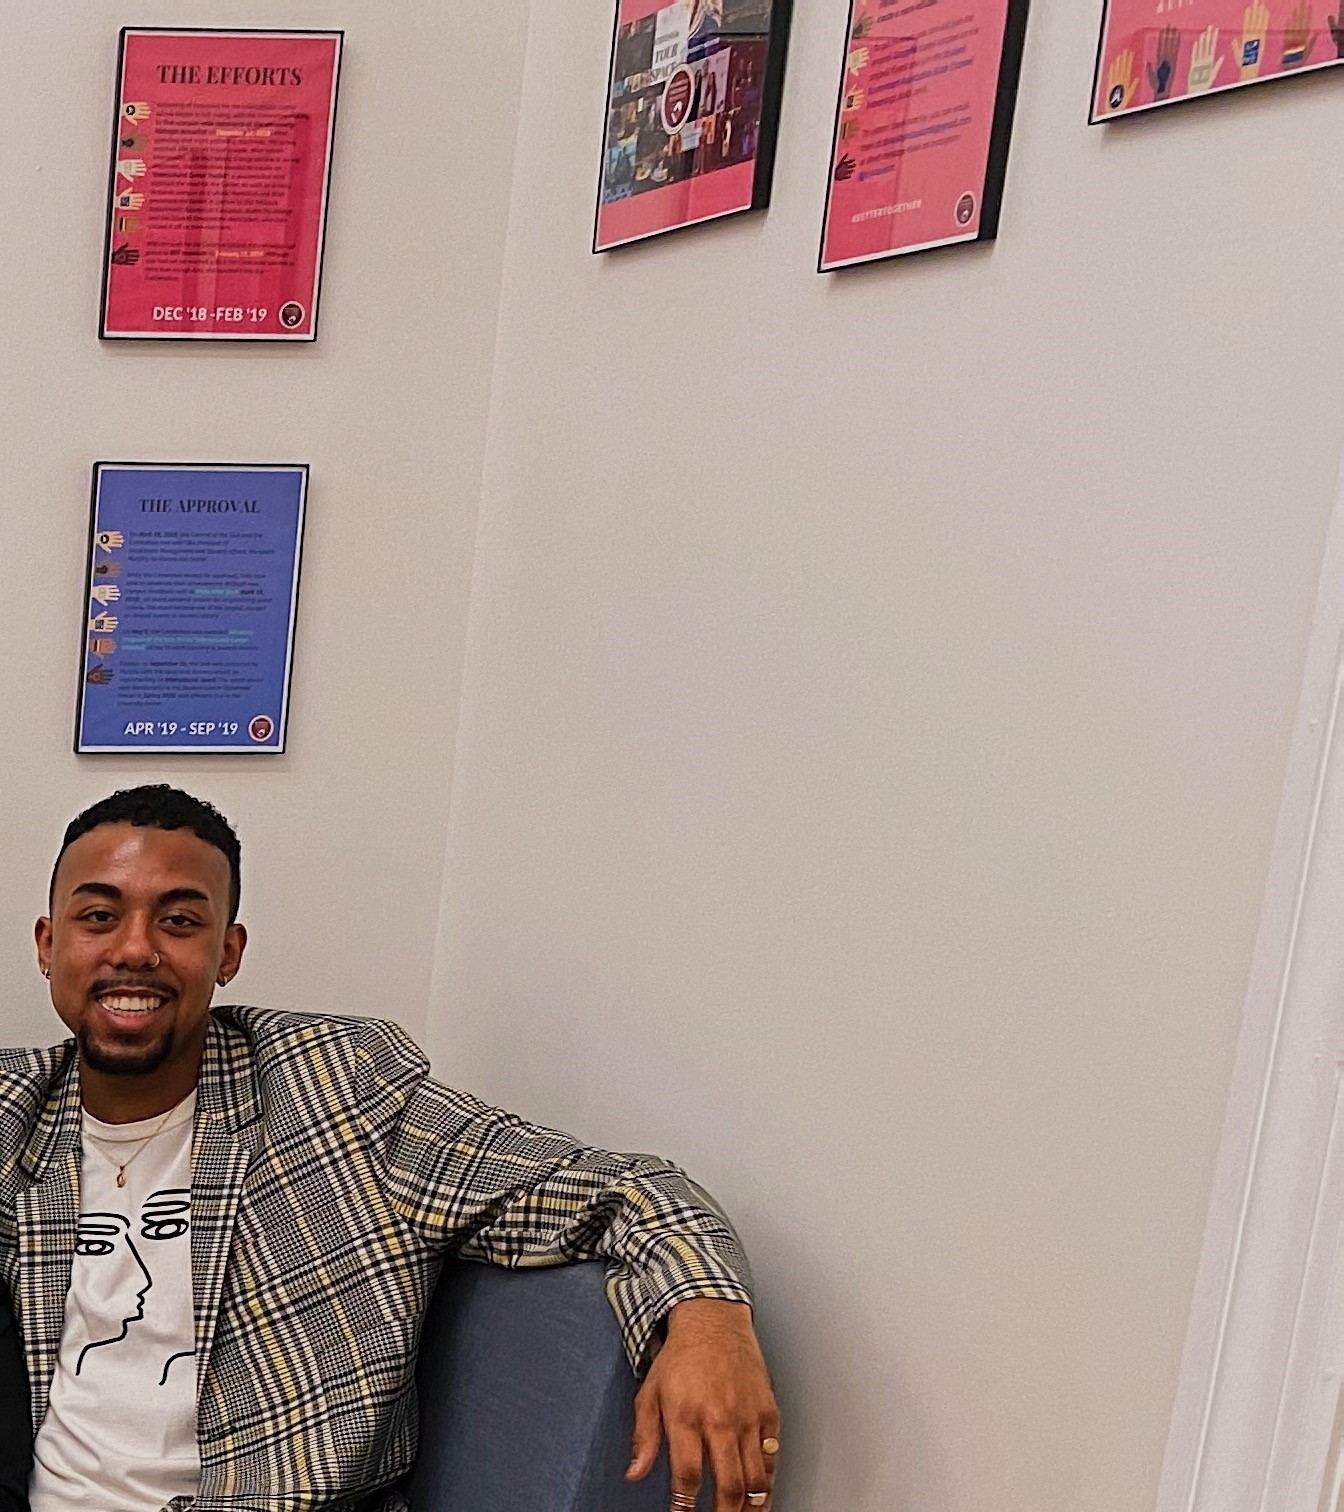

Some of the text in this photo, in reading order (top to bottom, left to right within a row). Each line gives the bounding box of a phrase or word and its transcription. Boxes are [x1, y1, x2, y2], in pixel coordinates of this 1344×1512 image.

[156, 64, 303, 86] THE EFFORTS
[152, 306, 184, 321] DEC
[138, 499, 261, 514] THE APPROVAL
[124, 722, 154, 735] APR
[189, 722, 216, 735] SEP
